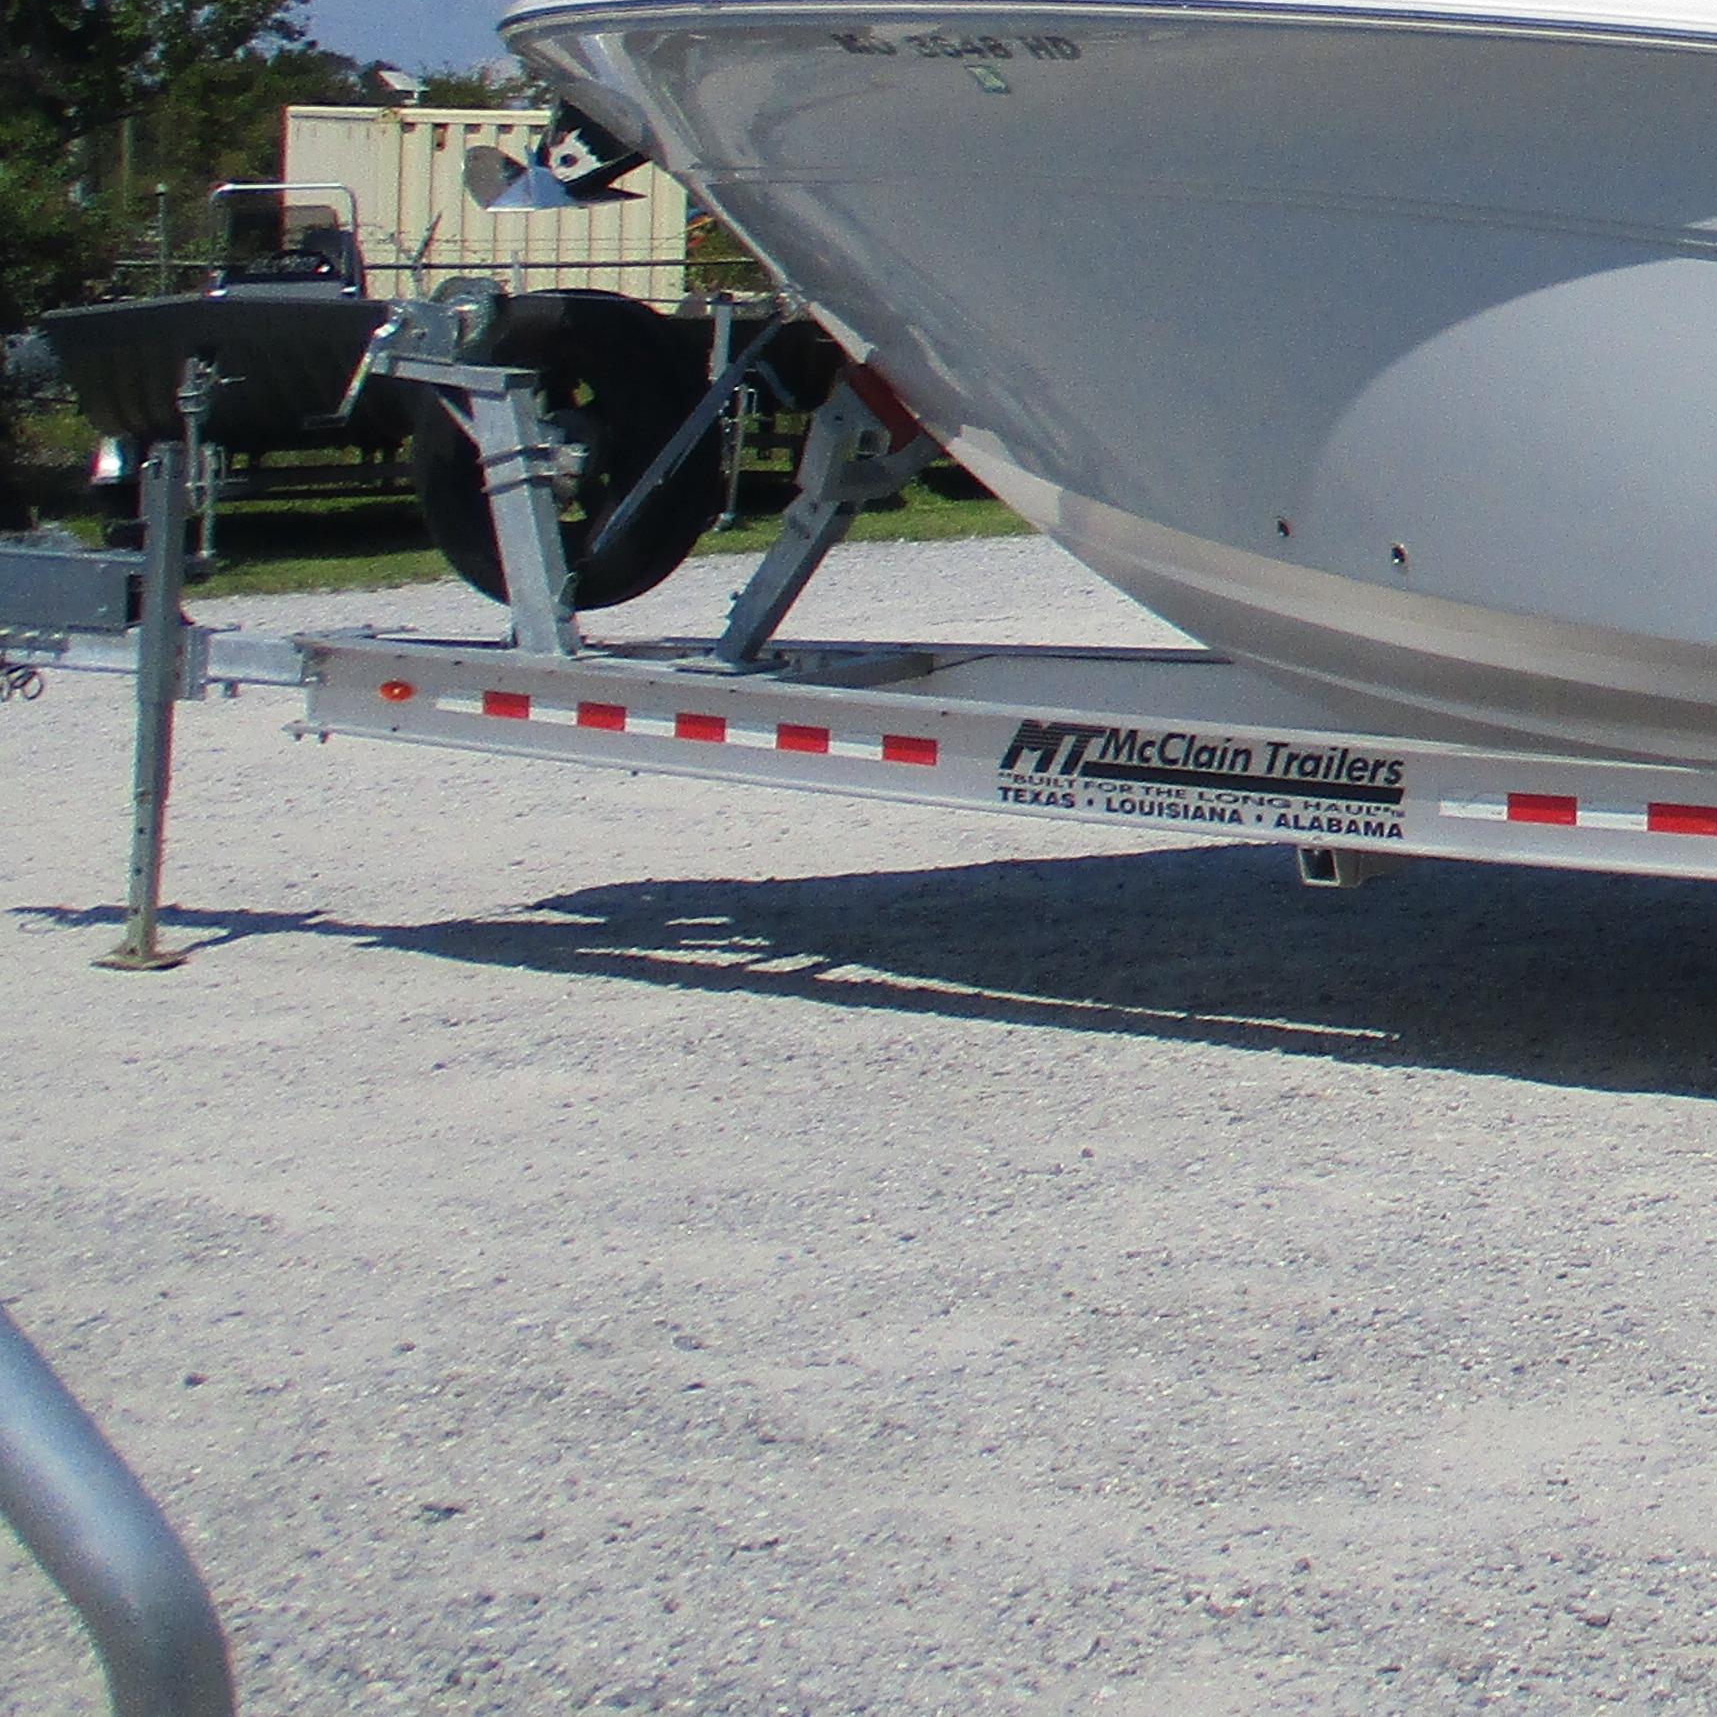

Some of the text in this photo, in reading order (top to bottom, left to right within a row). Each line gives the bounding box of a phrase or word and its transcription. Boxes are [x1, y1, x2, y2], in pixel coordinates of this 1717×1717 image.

[1099, 727, 1405, 785] McClain Trailers
[998, 786, 1405, 840] TEXAS LOUISIANA ALABAMA
[1141, 785, 1187, 799] THE
[1198, 791, 1292, 809] LONG
